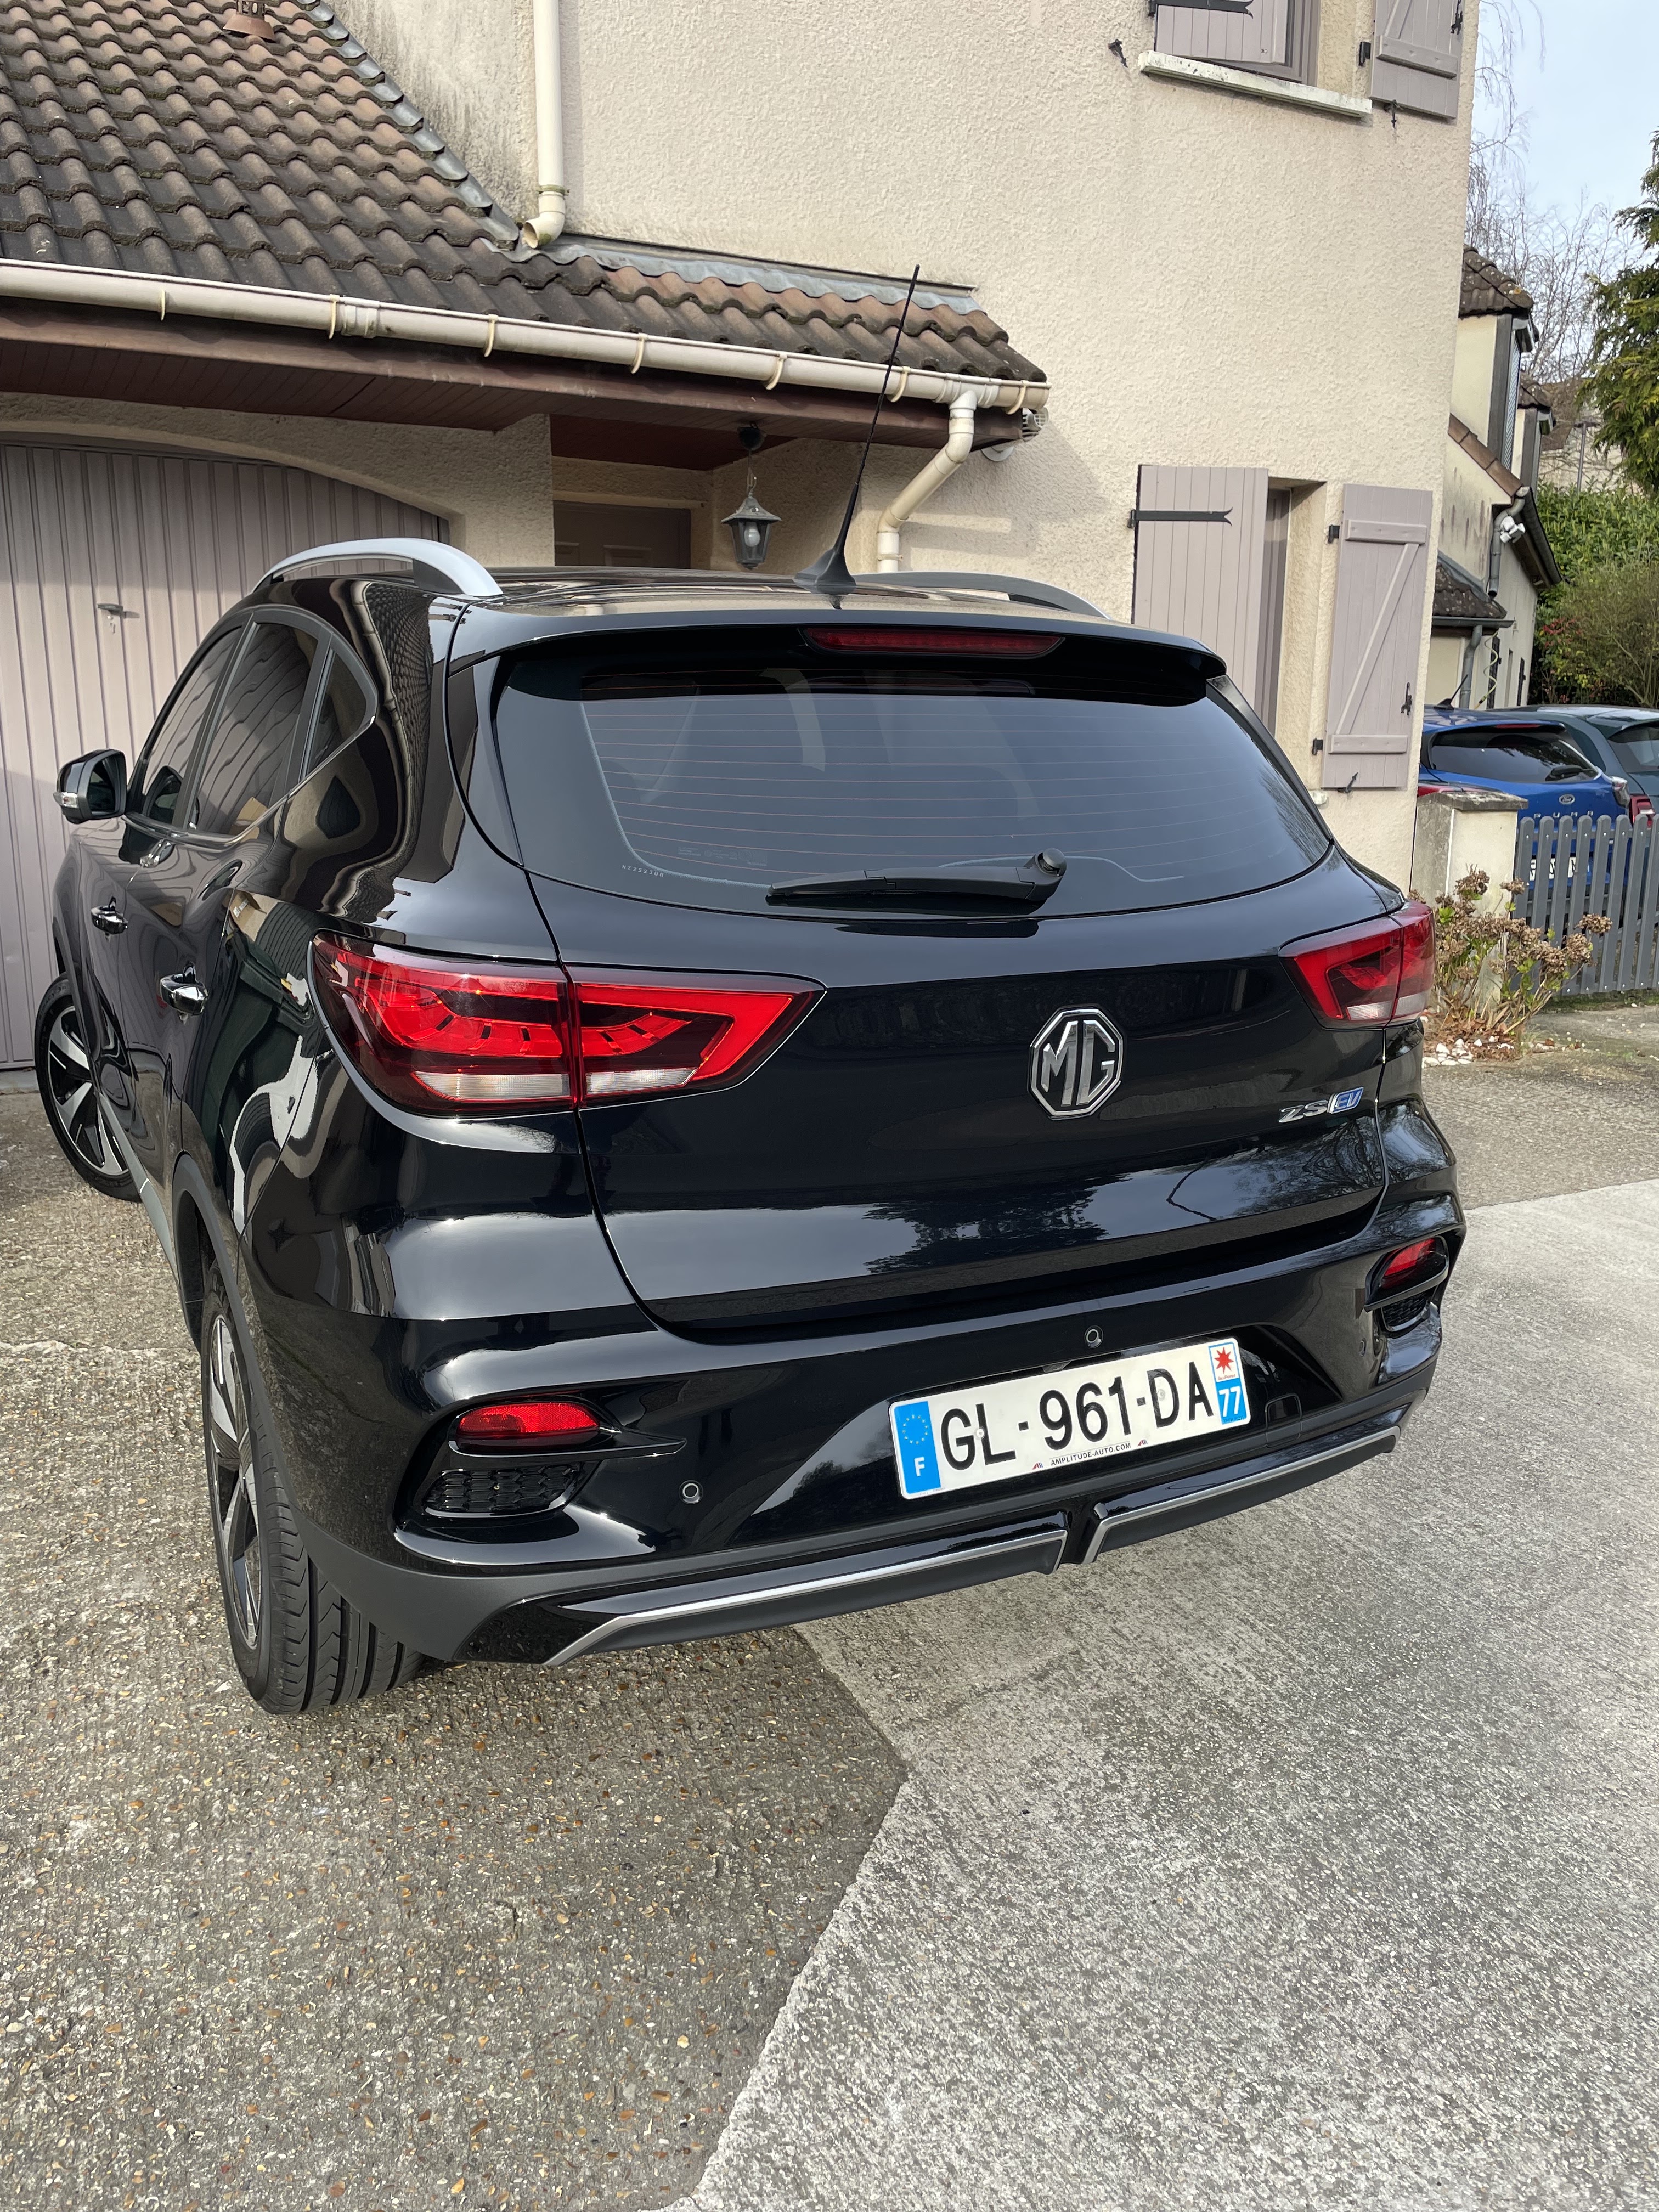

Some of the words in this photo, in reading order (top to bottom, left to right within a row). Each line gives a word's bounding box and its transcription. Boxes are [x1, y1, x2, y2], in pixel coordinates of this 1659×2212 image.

[1041, 1020, 1115, 1107] MG
[1278, 1099, 1328, 1123] ZS
[1335, 1091, 1361, 1110] EV
[940, 1362, 1214, 1471] GL-961-DA
[1218, 1386, 1240, 1417] 77
[913, 1457, 925, 1477] F
[1051, 1443, 1131, 1466] AMPLITUDE-AUTO.COM
